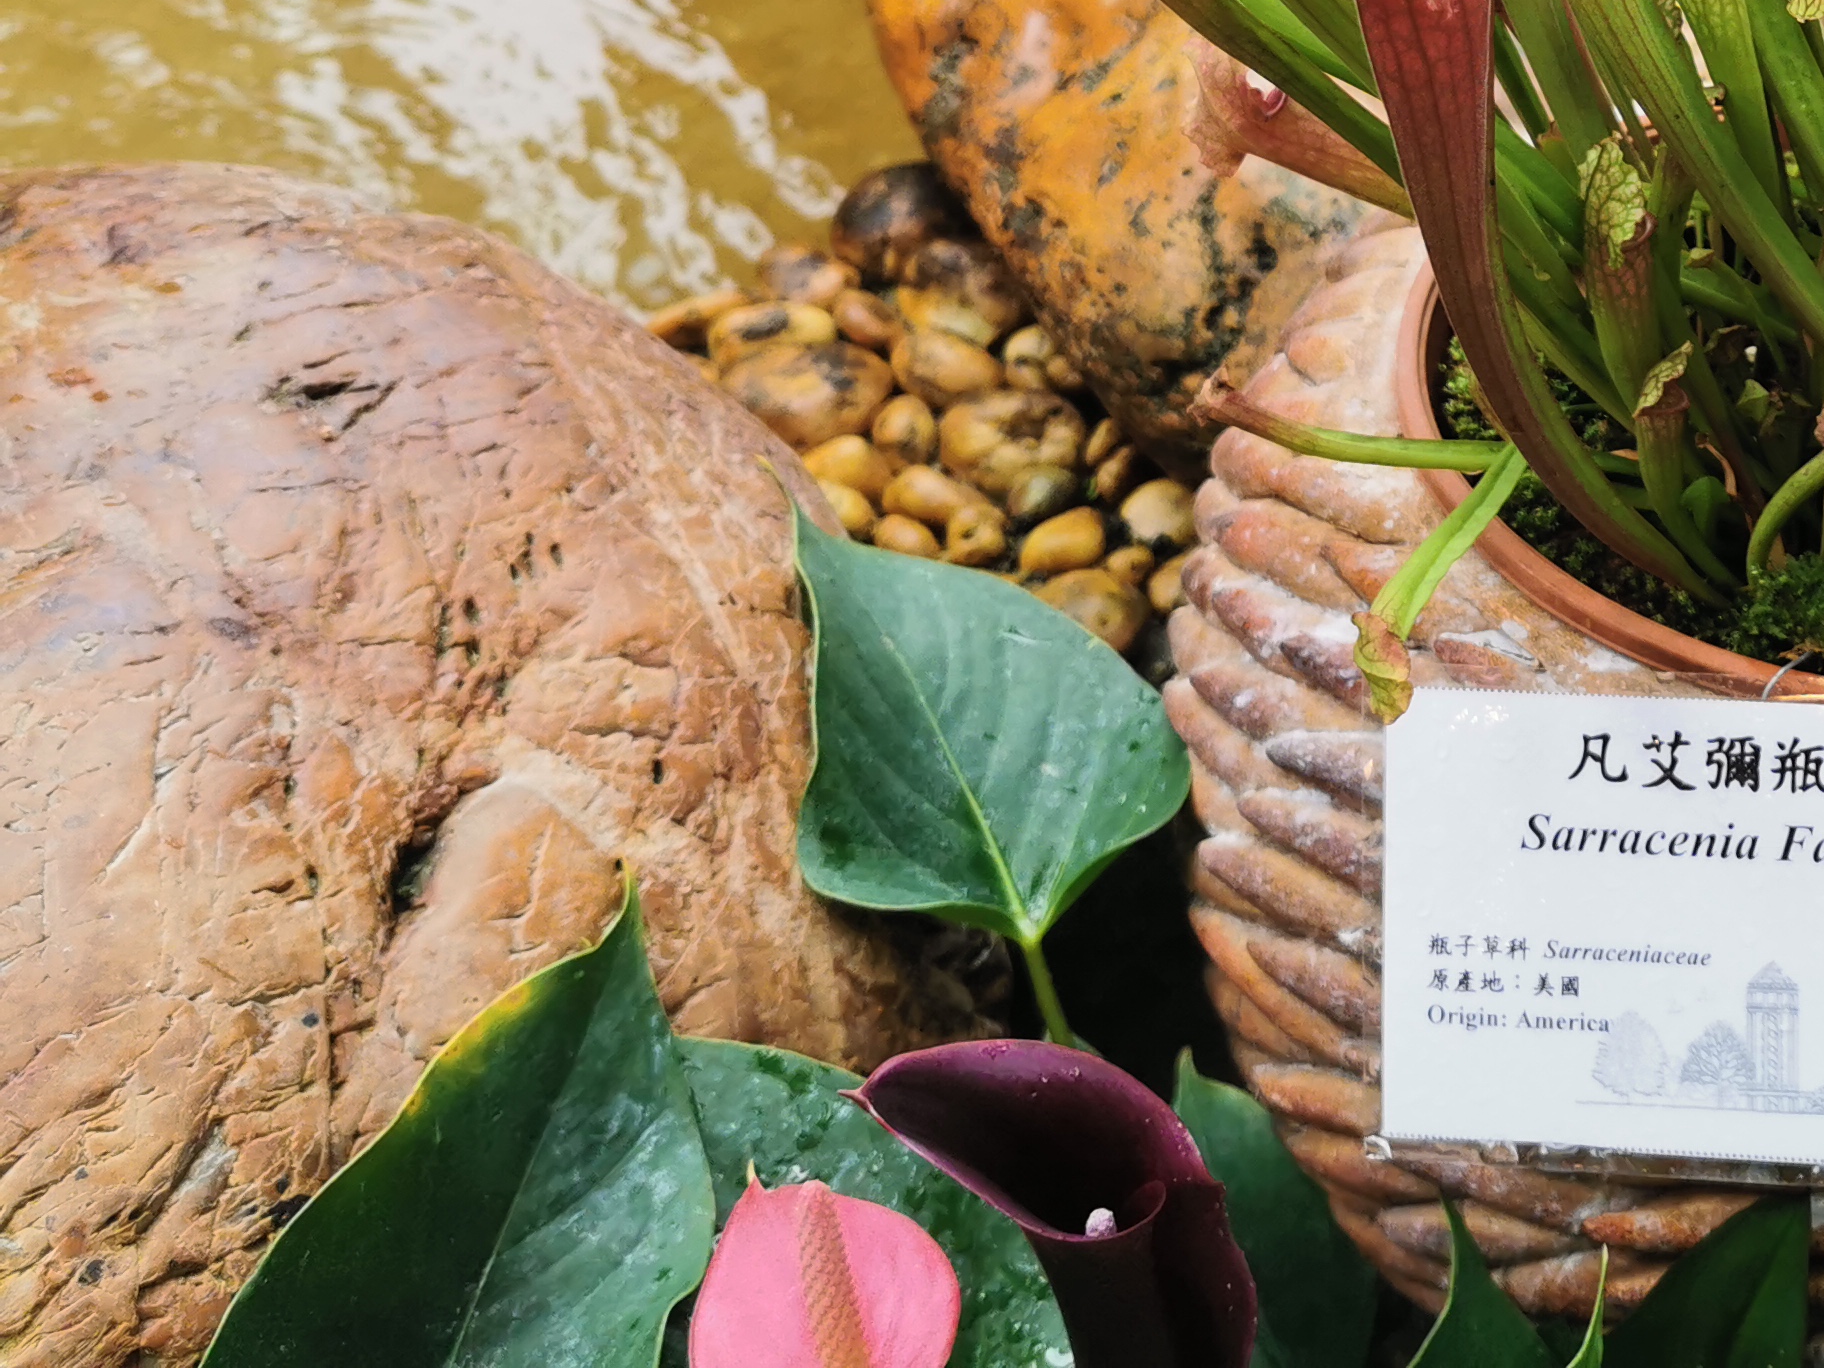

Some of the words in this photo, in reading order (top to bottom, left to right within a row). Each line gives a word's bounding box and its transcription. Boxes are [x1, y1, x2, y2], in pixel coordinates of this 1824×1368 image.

[1520, 814, 1759, 860] Sarracenia
[1428, 934, 1530, 961] 瓶子草科
[1543, 939, 1712, 966] Sarraceniaceae
[1427, 1004, 1507, 1031] Origin:
[1516, 1010, 1610, 1033] America
